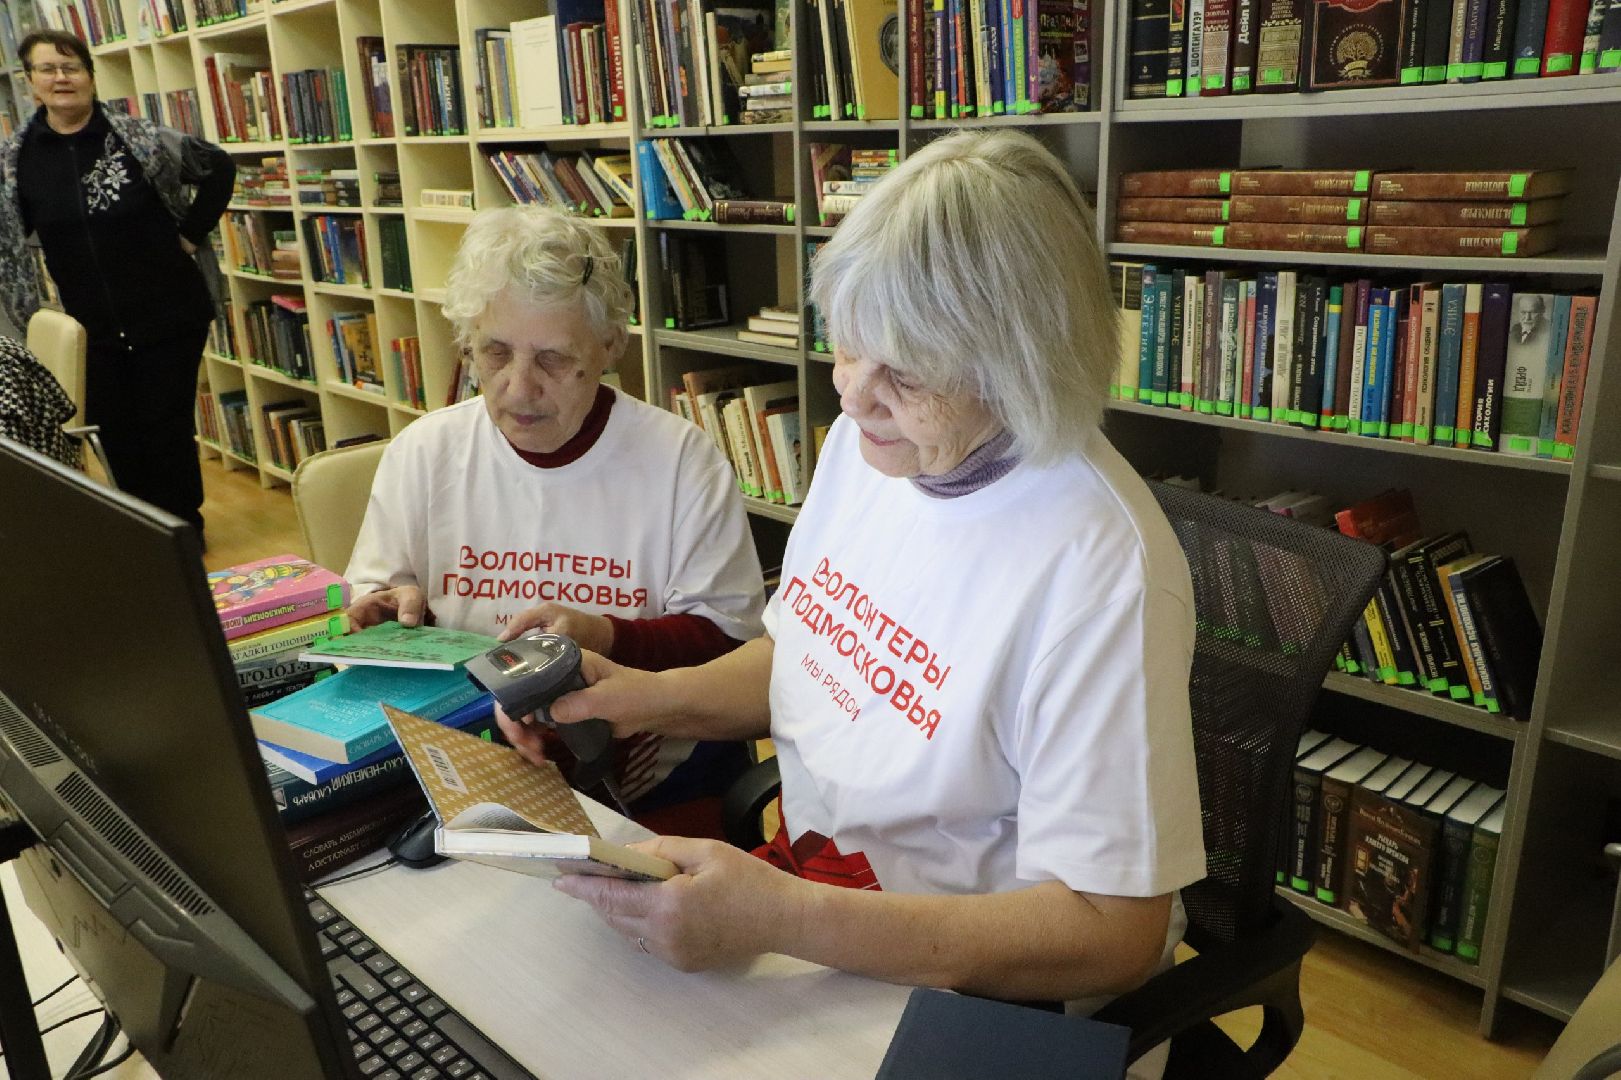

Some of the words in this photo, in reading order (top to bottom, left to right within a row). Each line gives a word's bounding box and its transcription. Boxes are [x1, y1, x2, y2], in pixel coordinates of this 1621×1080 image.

[1192, 10, 1202, 67] ШОПЕНГАУЭР
[1238, 9, 1250, 44] Дейл
[1444, 299, 1458, 336] ЭТИКА
[1474, 398, 1485, 432] СТОРИЯ
[1482, 379, 1495, 434] СИХОЛОГИИ
[459, 545, 631, 579] ВОЛОНТЕРЫ
[443, 573, 648, 608] ПОДМОСКОВЬЯ
[812, 556, 951, 691] ВОЛОНТЕРЫ
[783, 577, 942, 741] ПОДМОСКОВЬЯ
[801, 653, 821, 679] МЫ
[293, 785, 332, 806] СЛОВАРЬ
[303, 839, 338, 858] СЛОВАРЬ
[315, 841, 361, 867] DICTIONARY
